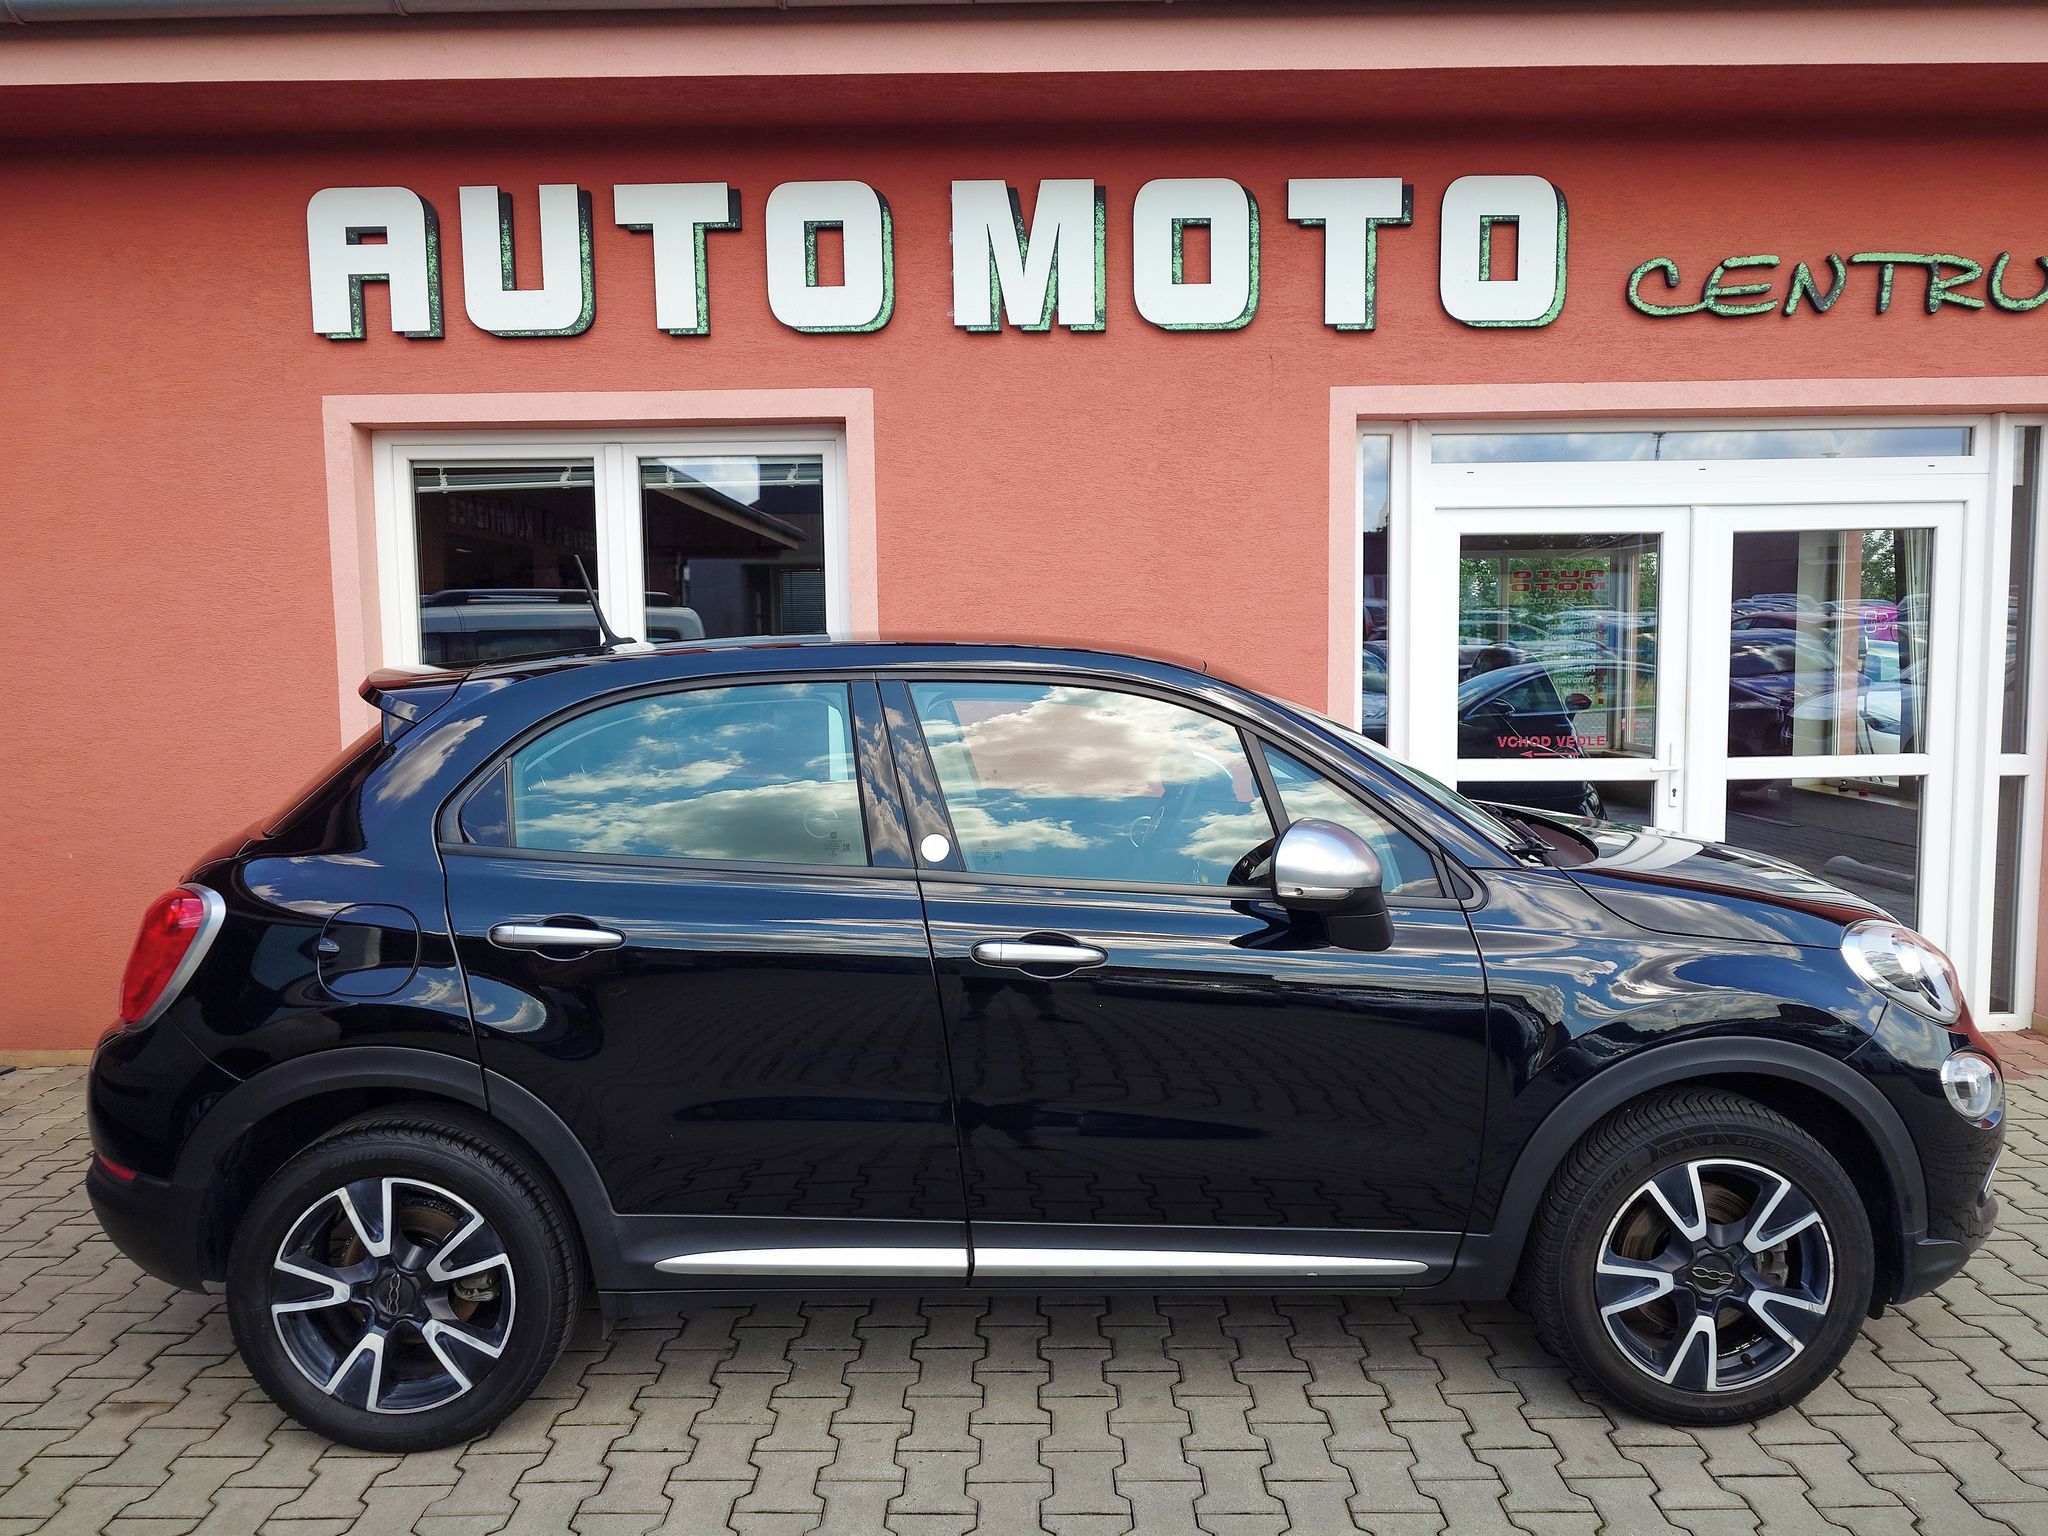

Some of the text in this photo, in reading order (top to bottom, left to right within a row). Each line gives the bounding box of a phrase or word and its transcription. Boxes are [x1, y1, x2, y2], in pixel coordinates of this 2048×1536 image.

[307, 175, 2048, 338] AUTO MOTO CENTRU
[1496, 735, 1605, 747] VCHOD VEDLE
